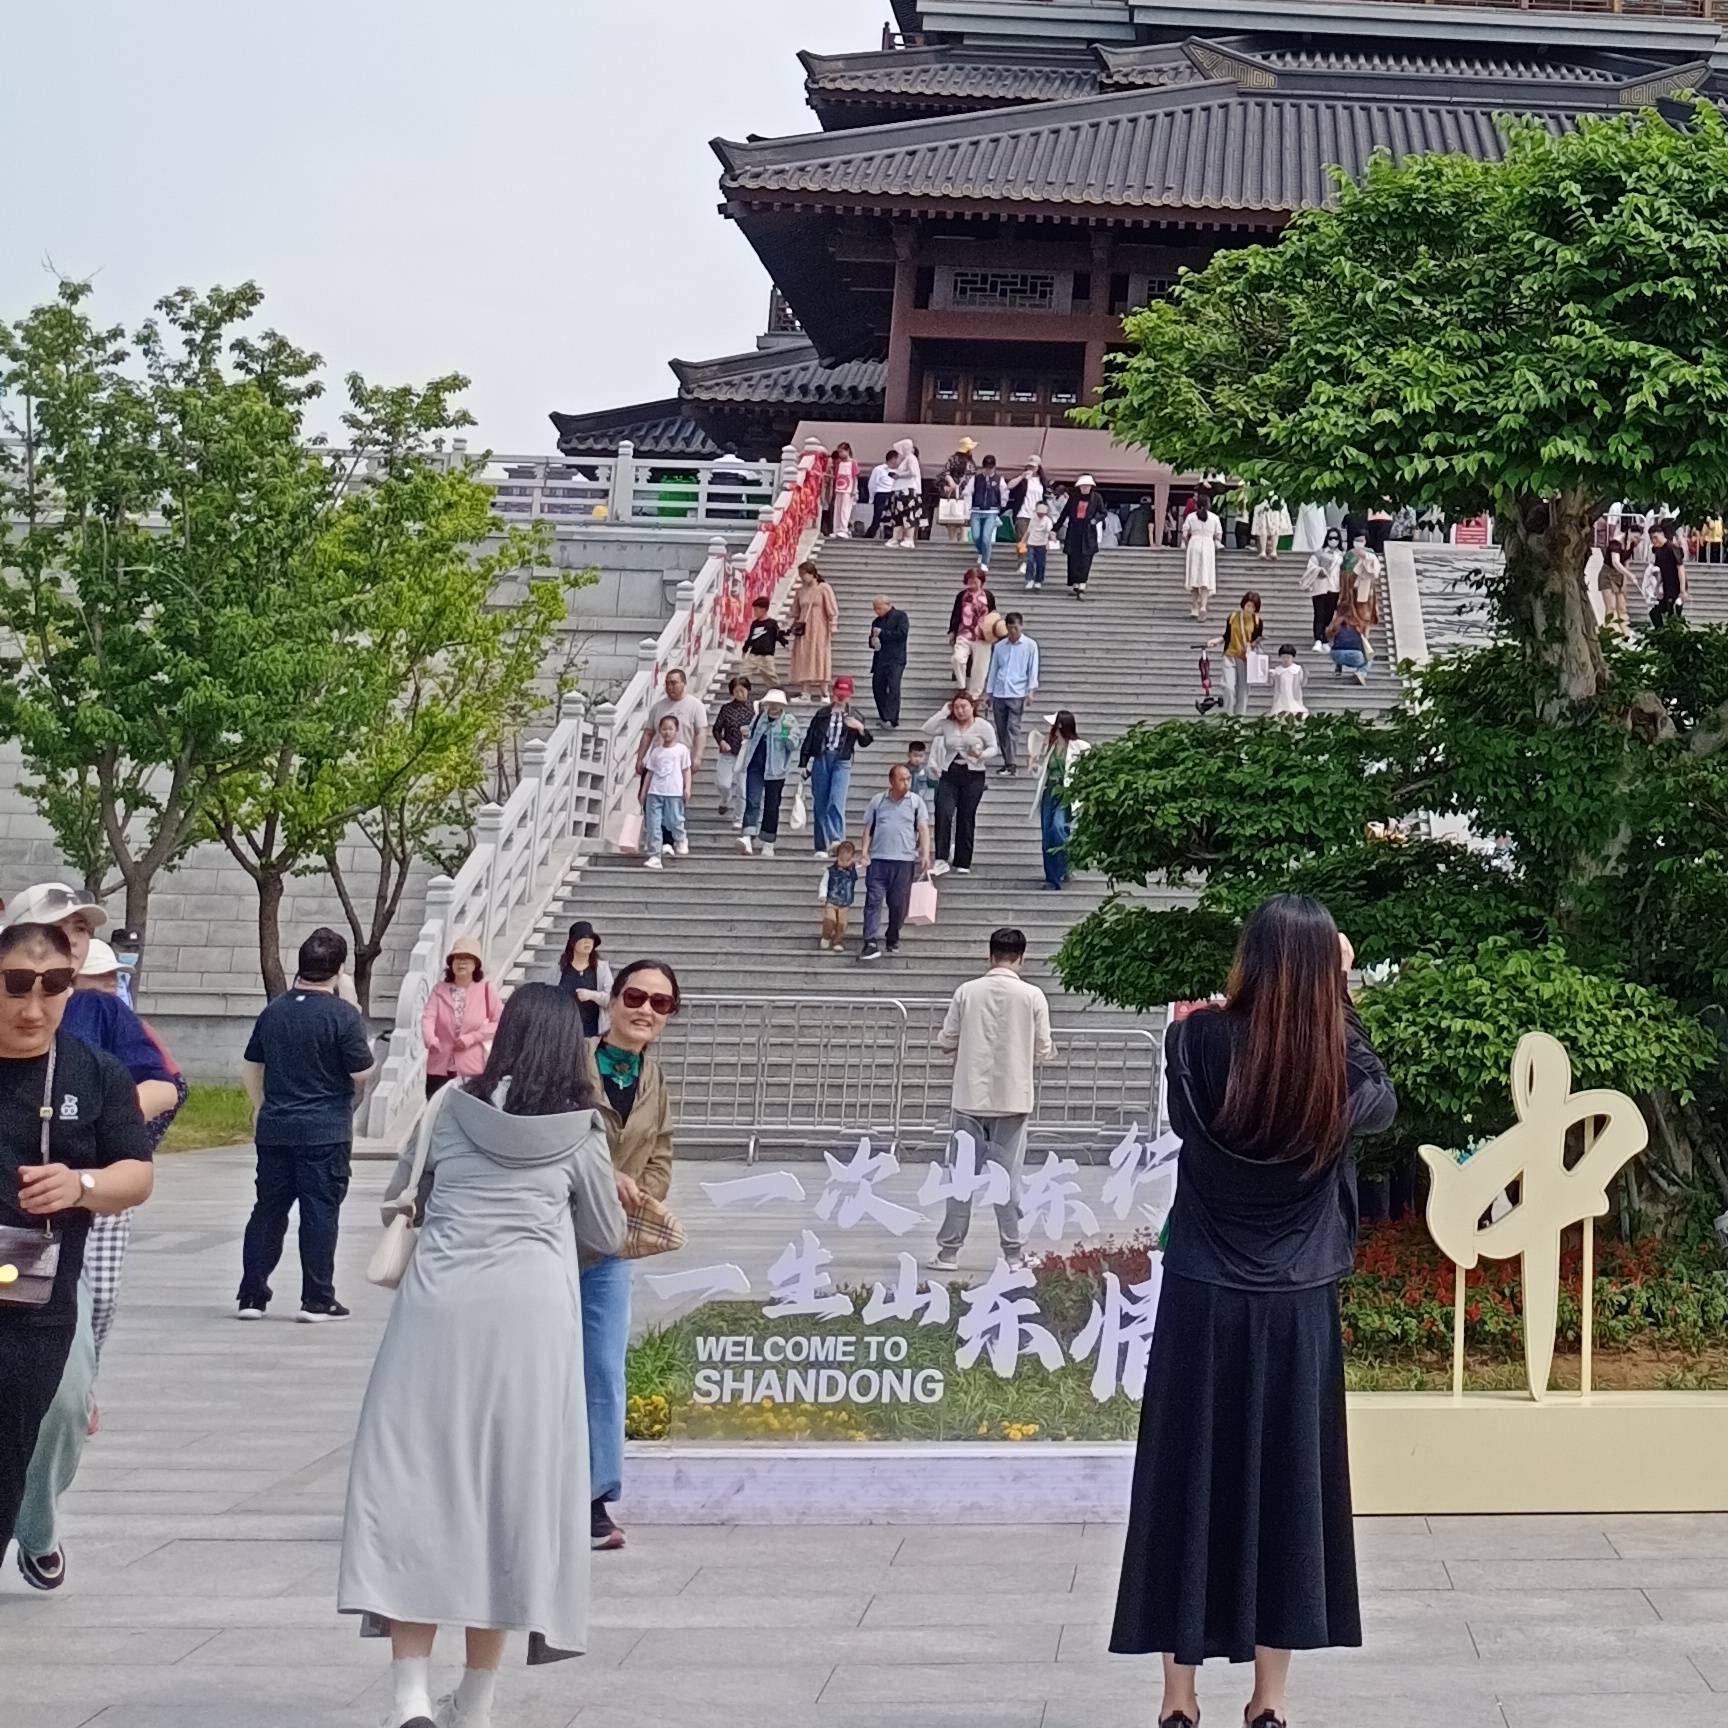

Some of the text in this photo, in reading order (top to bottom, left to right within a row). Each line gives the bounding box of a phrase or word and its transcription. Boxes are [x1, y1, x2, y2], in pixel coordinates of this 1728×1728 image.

[695, 1335, 908, 1362] WELCOME TO
[693, 1368, 945, 1404] SHANDONG
